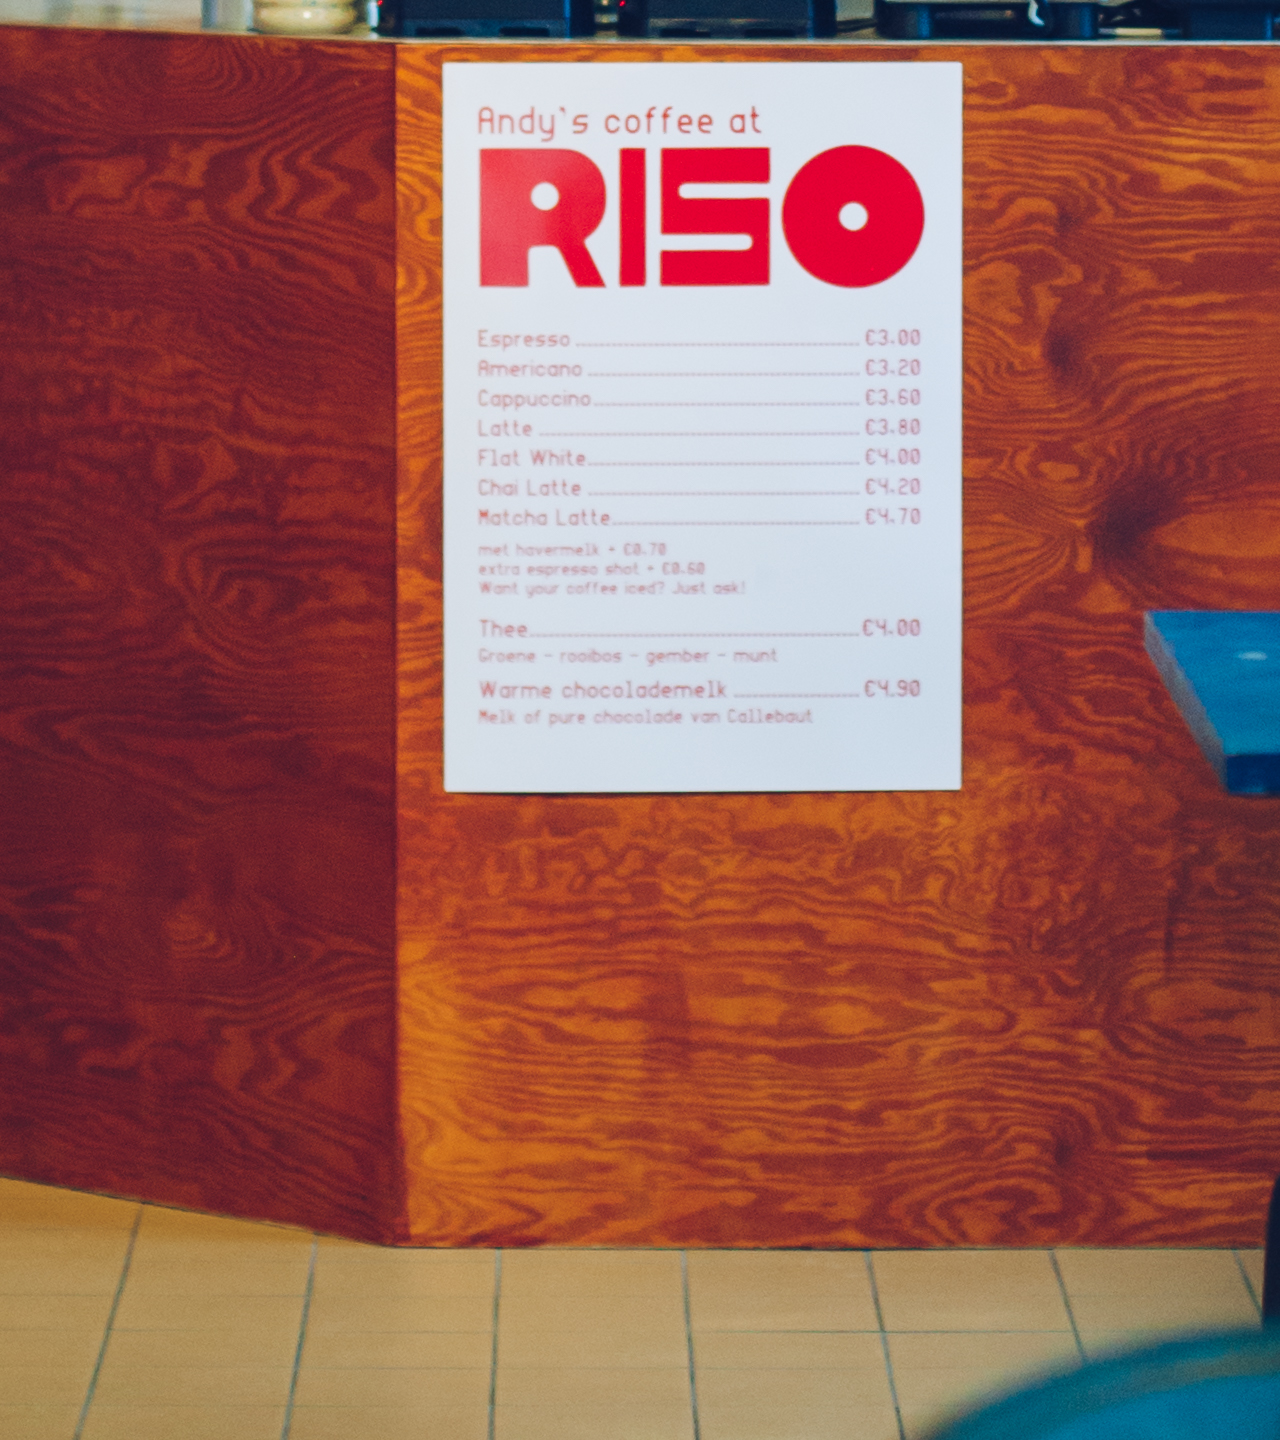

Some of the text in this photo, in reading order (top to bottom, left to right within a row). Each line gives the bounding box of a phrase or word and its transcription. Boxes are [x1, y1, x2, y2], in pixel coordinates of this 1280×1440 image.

[478, 106, 762, 142] Andy's coffee at
[478, 144, 926, 289] RISO
[477, 328, 923, 349] Espresso €3.00
[477, 358, 923, 378] Americano €3.20
[477, 388, 923, 409] Cappuccino €3.60
[477, 417, 923, 437] Latte €3.80
[477, 447, 923, 467] Flat White €4.00
[477, 476, 923, 497] Chai Latte €4.20
[477, 506, 923, 527] Matcha Latte €4.70
[478, 542, 509, 557] met
[516, 542, 600, 557] havermelk
[478, 562, 520, 576] extra
[527, 562, 598, 579] espresso
[605, 562, 639, 576] shot
[478, 581, 746, 600] Want your coffee iced? Just ask!
[478, 617, 923, 639] Thee €4.00
[478, 649, 537, 665] Groene
[559, 649, 623, 665] rooibos
[646, 649, 710, 667] gember
[732, 649, 778, 665] munt
[478, 678, 923, 700] Warme chocolademelk €4.90
[478, 708, 814, 729] Melk of pure chocolade van Callebaut
